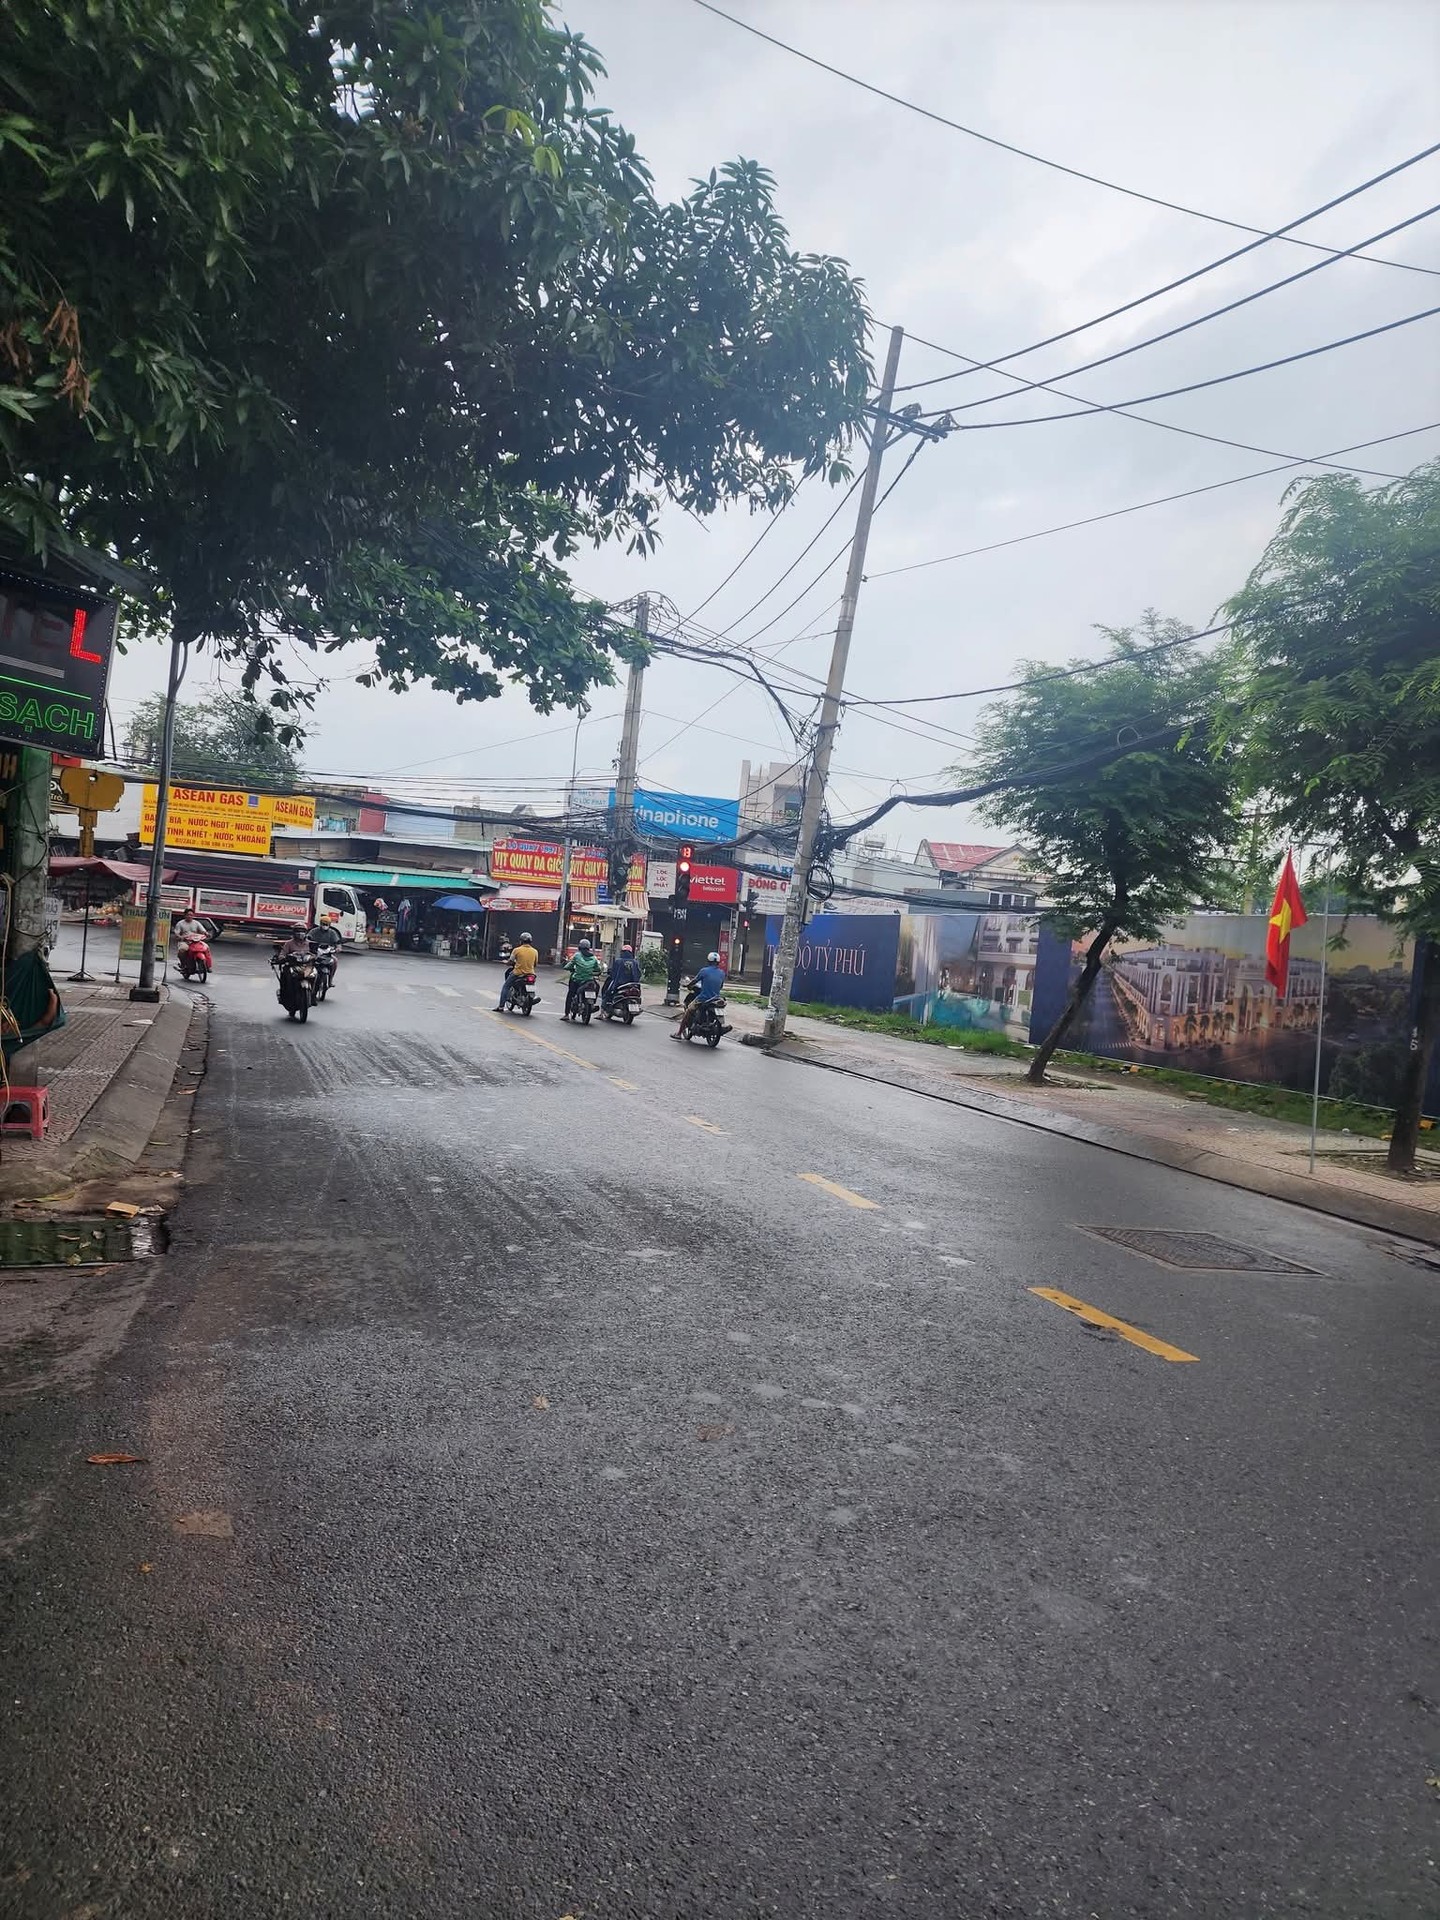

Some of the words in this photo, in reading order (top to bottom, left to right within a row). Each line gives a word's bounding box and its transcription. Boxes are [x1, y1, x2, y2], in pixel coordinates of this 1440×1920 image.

[173, 788, 215, 803] ASEAN
[220, 793, 244, 806] GAS
[275, 801, 298, 815] ASEAN
[300, 806, 313, 818] GAS
[169, 816, 182, 825] BIA
[509, 853, 533, 870] QUAY
[534, 856, 545, 870] DA
[690, 875, 726, 886] viettel
